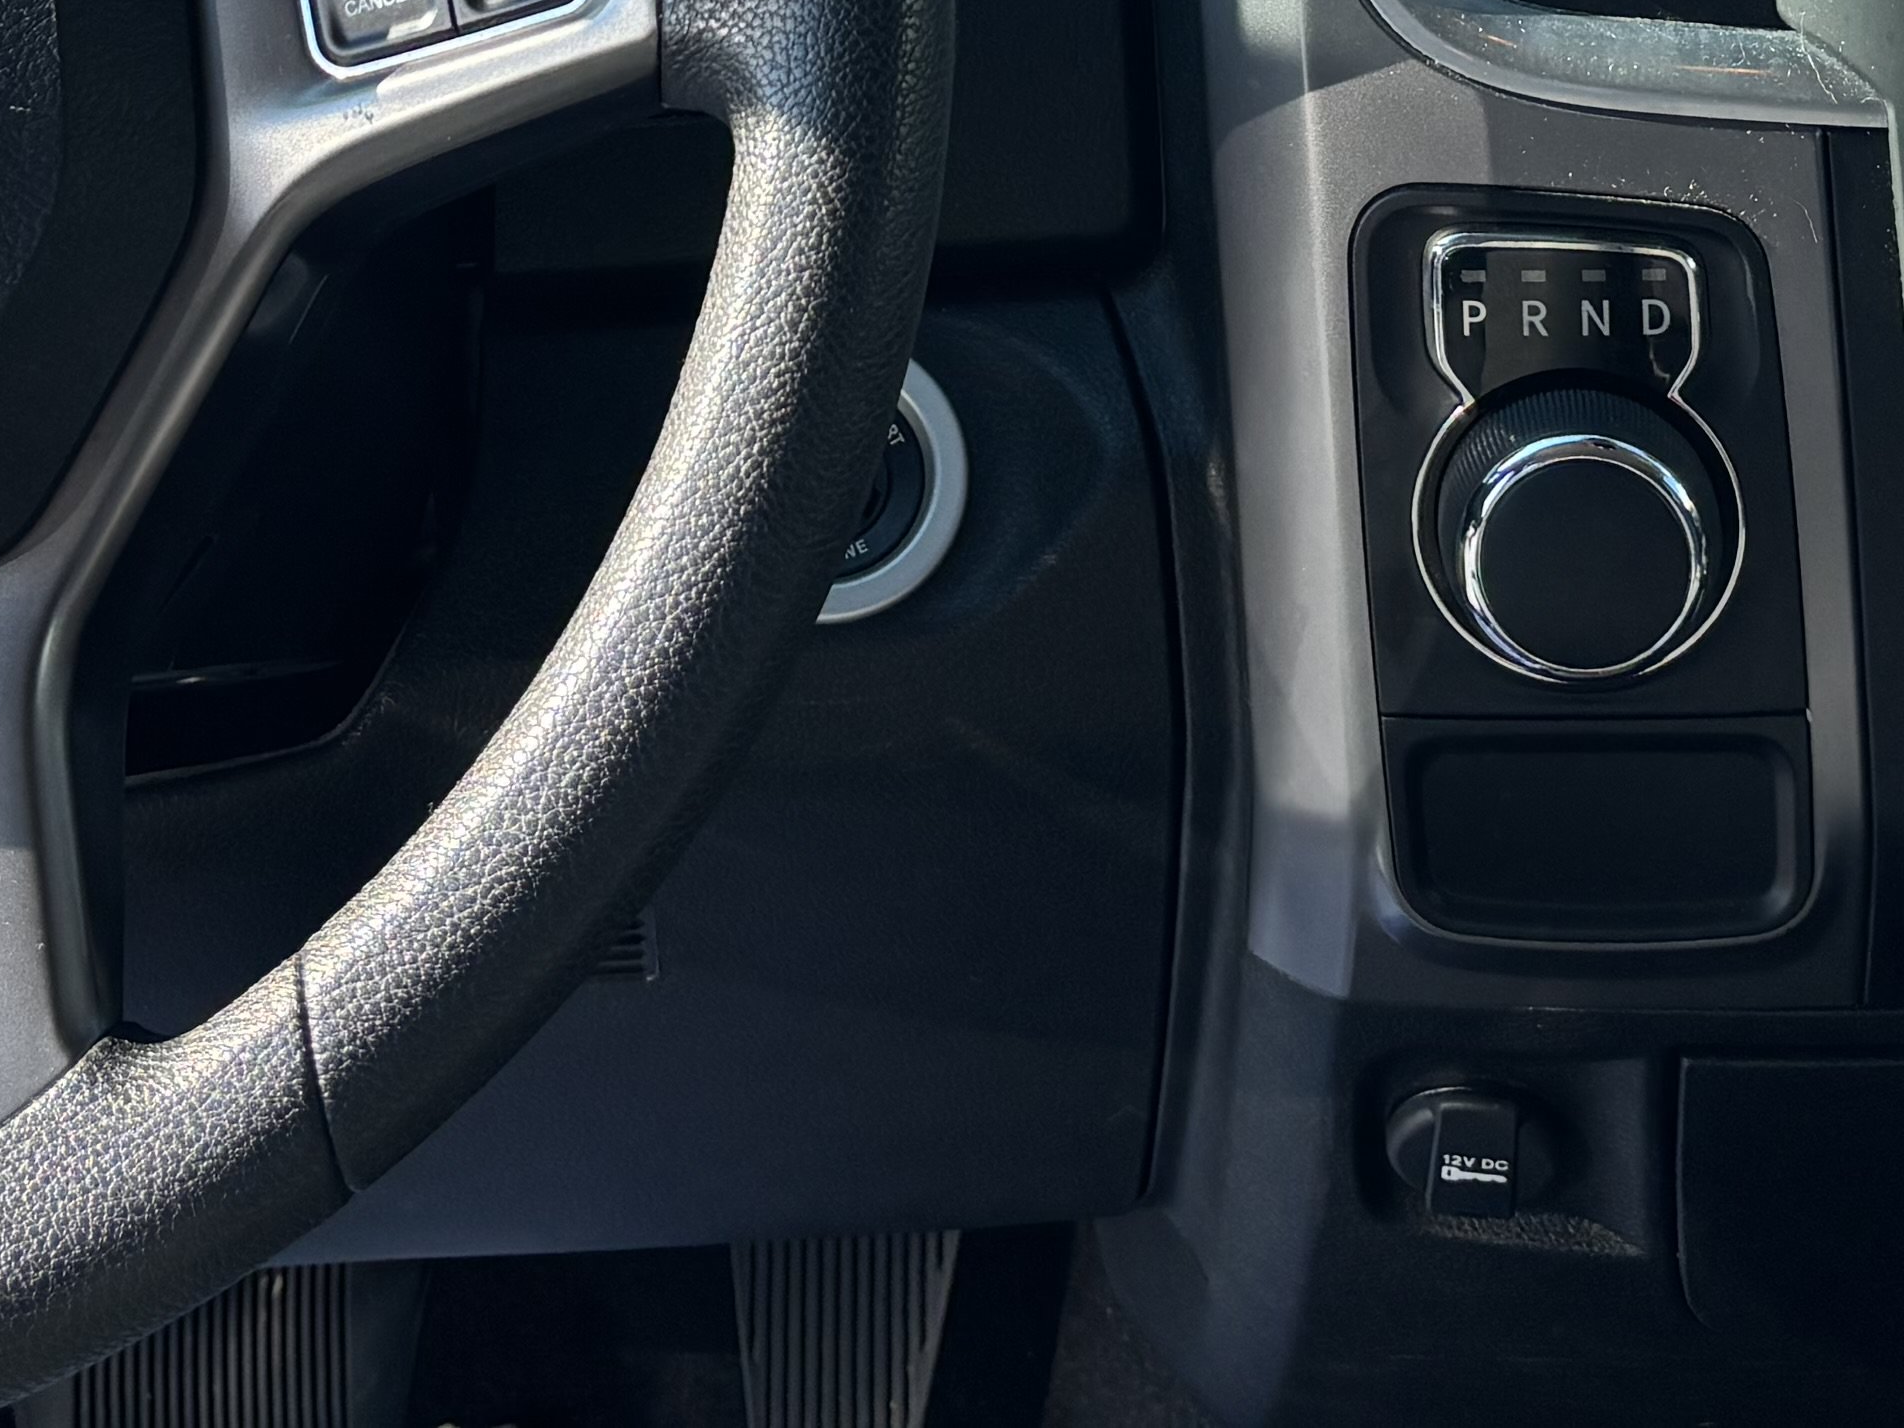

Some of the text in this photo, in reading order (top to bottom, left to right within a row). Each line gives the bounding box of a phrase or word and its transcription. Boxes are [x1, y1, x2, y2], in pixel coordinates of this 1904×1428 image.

[1462, 298, 1671, 337] P R N D
[1442, 1154, 1509, 1171] 12V DC
